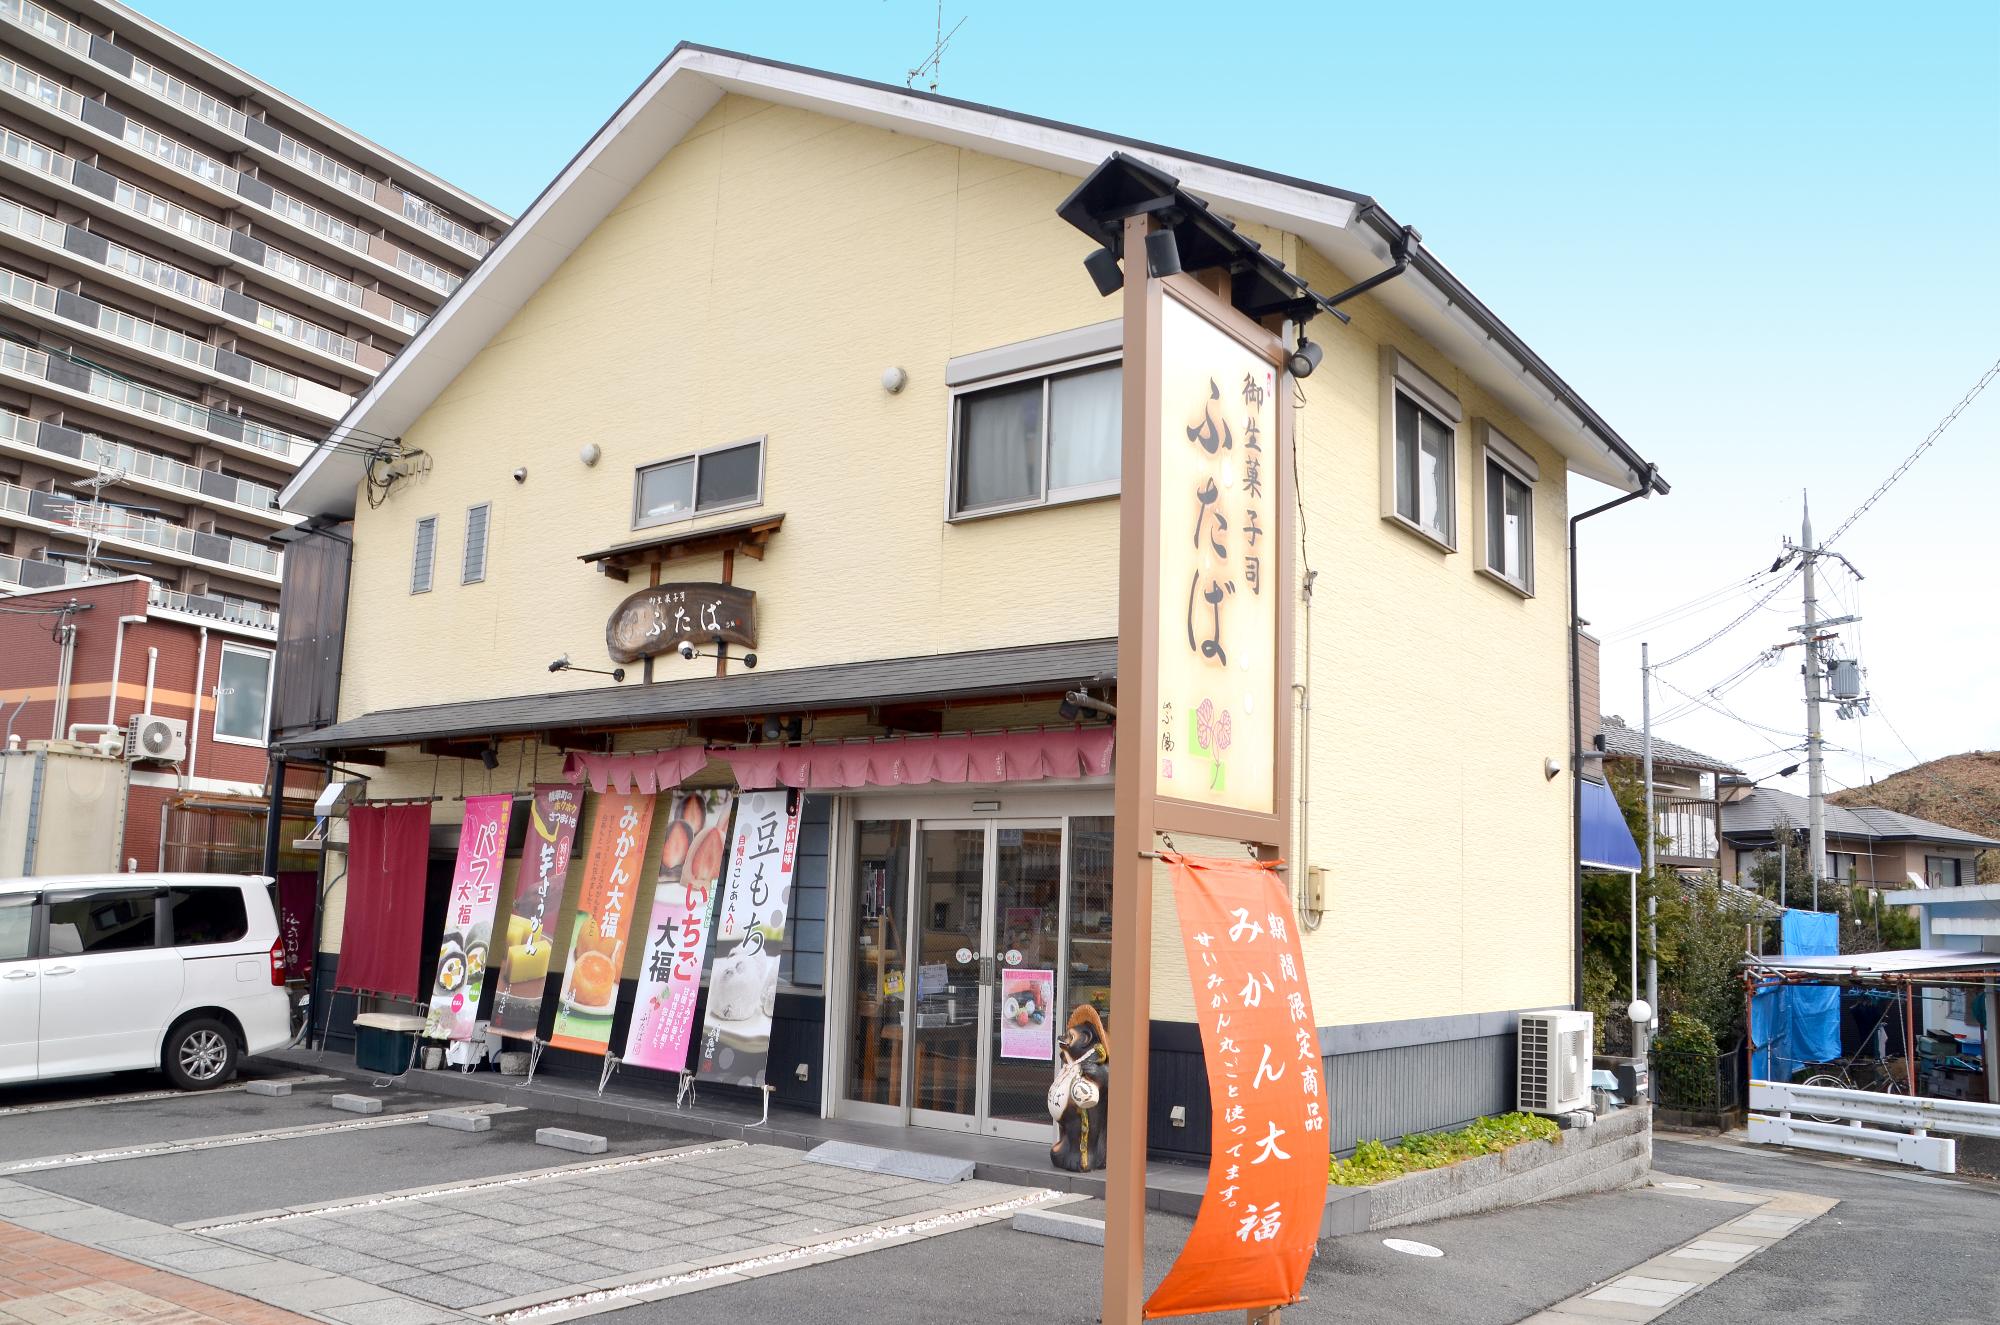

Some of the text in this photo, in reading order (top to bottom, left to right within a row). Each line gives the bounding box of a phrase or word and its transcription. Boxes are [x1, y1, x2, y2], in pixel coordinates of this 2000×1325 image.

[1186, 376, 1236, 667] ふたば
[1242, 372, 1264, 595] 御生菓子司
[646, 600, 722, 637] ふたば
[549, 812, 577, 828] さつまいも
[554, 800, 578, 815] ホクホク
[783, 815, 797, 864] よい塩味
[456, 880, 473, 925] 大福
[470, 821, 497, 905] パフェ
[600, 805, 638, 938] みかん大福
[725, 835, 746, 935] 自慢のこしあん入り
[742, 810, 779, 956] 豆もち
[649, 916, 679, 984] 大福
[673, 883, 708, 981] いちご
[1193, 931, 1247, 1209] 甘いみかん丸ごと使ってます。
[1267, 912, 1323, 1133] 期間限定商品
[1228, 907, 1293, 1243] みかん大福
